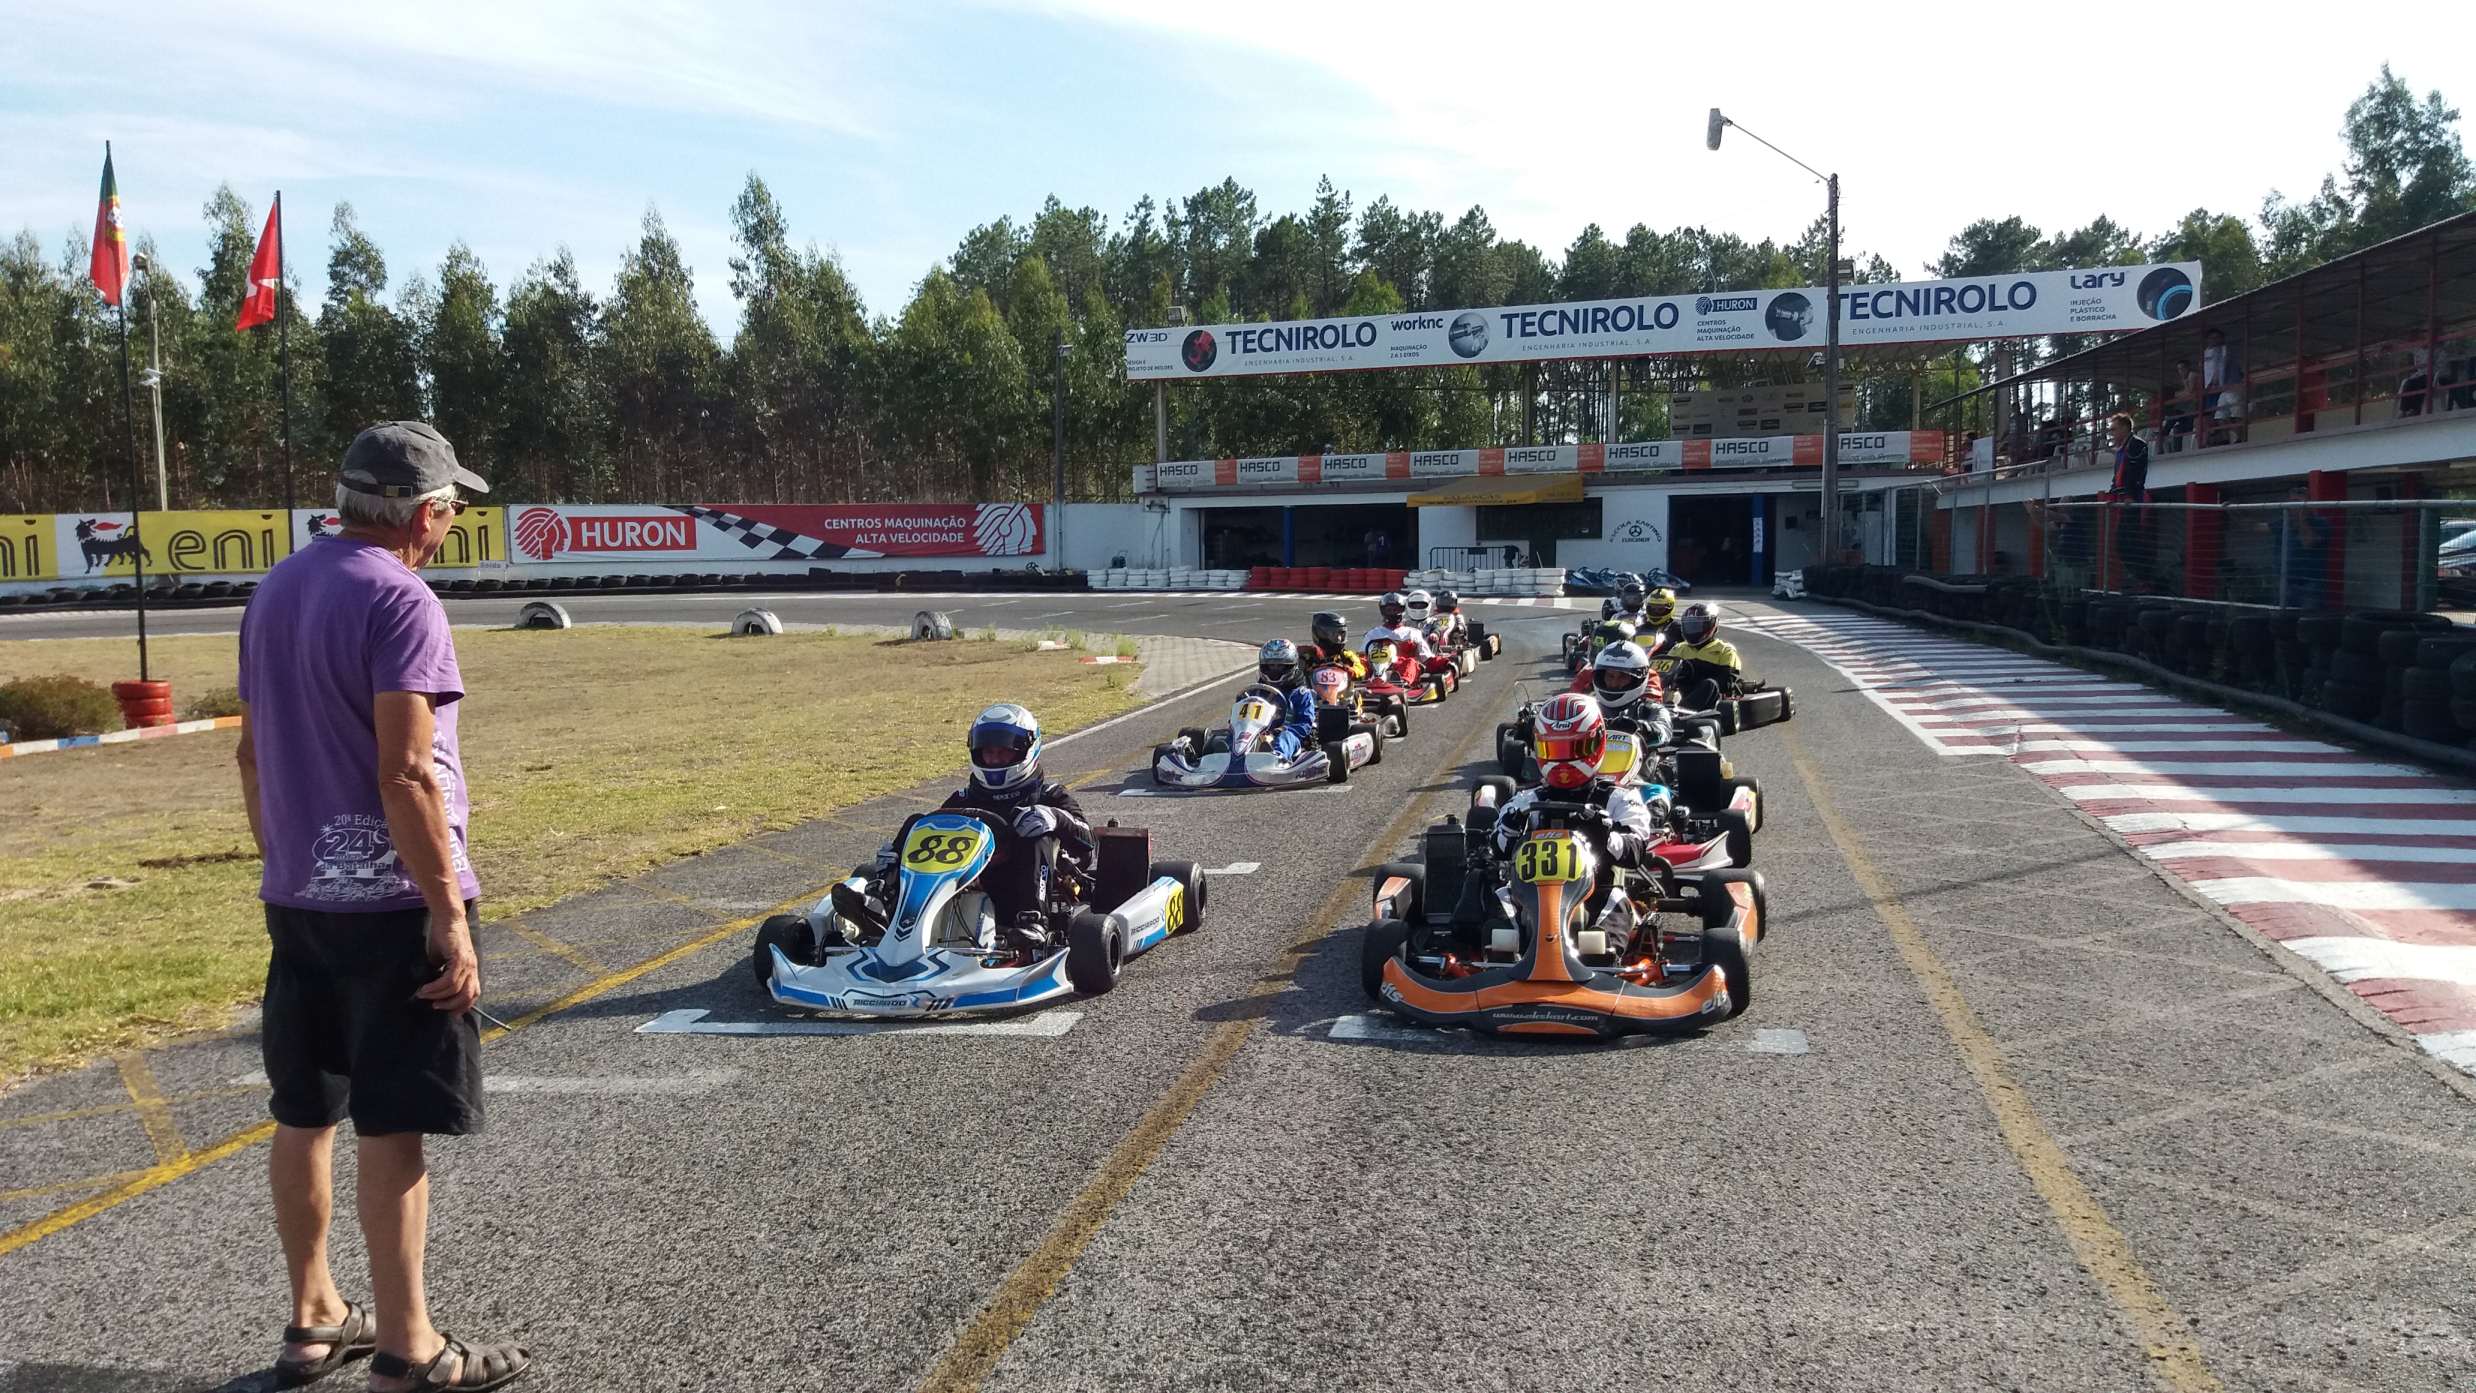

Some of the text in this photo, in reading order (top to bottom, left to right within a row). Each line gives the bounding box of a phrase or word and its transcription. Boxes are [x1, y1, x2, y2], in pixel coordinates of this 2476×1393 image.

[1716, 299, 1755, 311] HURON
[1500, 302, 1680, 339] TECNIROLO
[1697, 319, 1727, 327] CENTROS
[2076, 314, 2117, 322] BORRACHA
[1697, 326, 1741, 335] MAQUINAÇÃO
[1852, 325, 1915, 336] ENGENHARIA
[1126, 332, 1168, 344] ZW3D
[1225, 321, 1377, 355] TECNIROLO
[1697, 333, 1755, 342] ALTA VELOCIDADE
[1522, 342, 1576, 352] ENGENHARIA
[1715, 441, 1769, 454] HASCO
[1840, 436, 1885, 449] ASCO
[1508, 450, 1556, 462] HASCO
[1608, 445, 1660, 459] HASCO
[1324, 458, 1367, 470] HASCO
[1413, 454, 1459, 466] HASCO
[1159, 464, 1198, 476] HASCO
[1239, 461, 1280, 473] HASCO
[824, 514, 966, 531] CENTROS MAQUINAÇÃO
[434, 511, 490, 563] ni
[581, 520, 686, 548] HURON
[855, 532, 965, 544] ALTA VELOCIDADE
[168, 514, 275, 570] eni
[1371, 648, 1388, 659] 25
[1320, 672, 1337, 683] 83
[1239, 703, 1263, 720] 41
[323, 829, 375, 860] 24
[907, 834, 975, 865] 88
[1520, 841, 1578, 881] 331
[1167, 890, 1184, 933] 88
